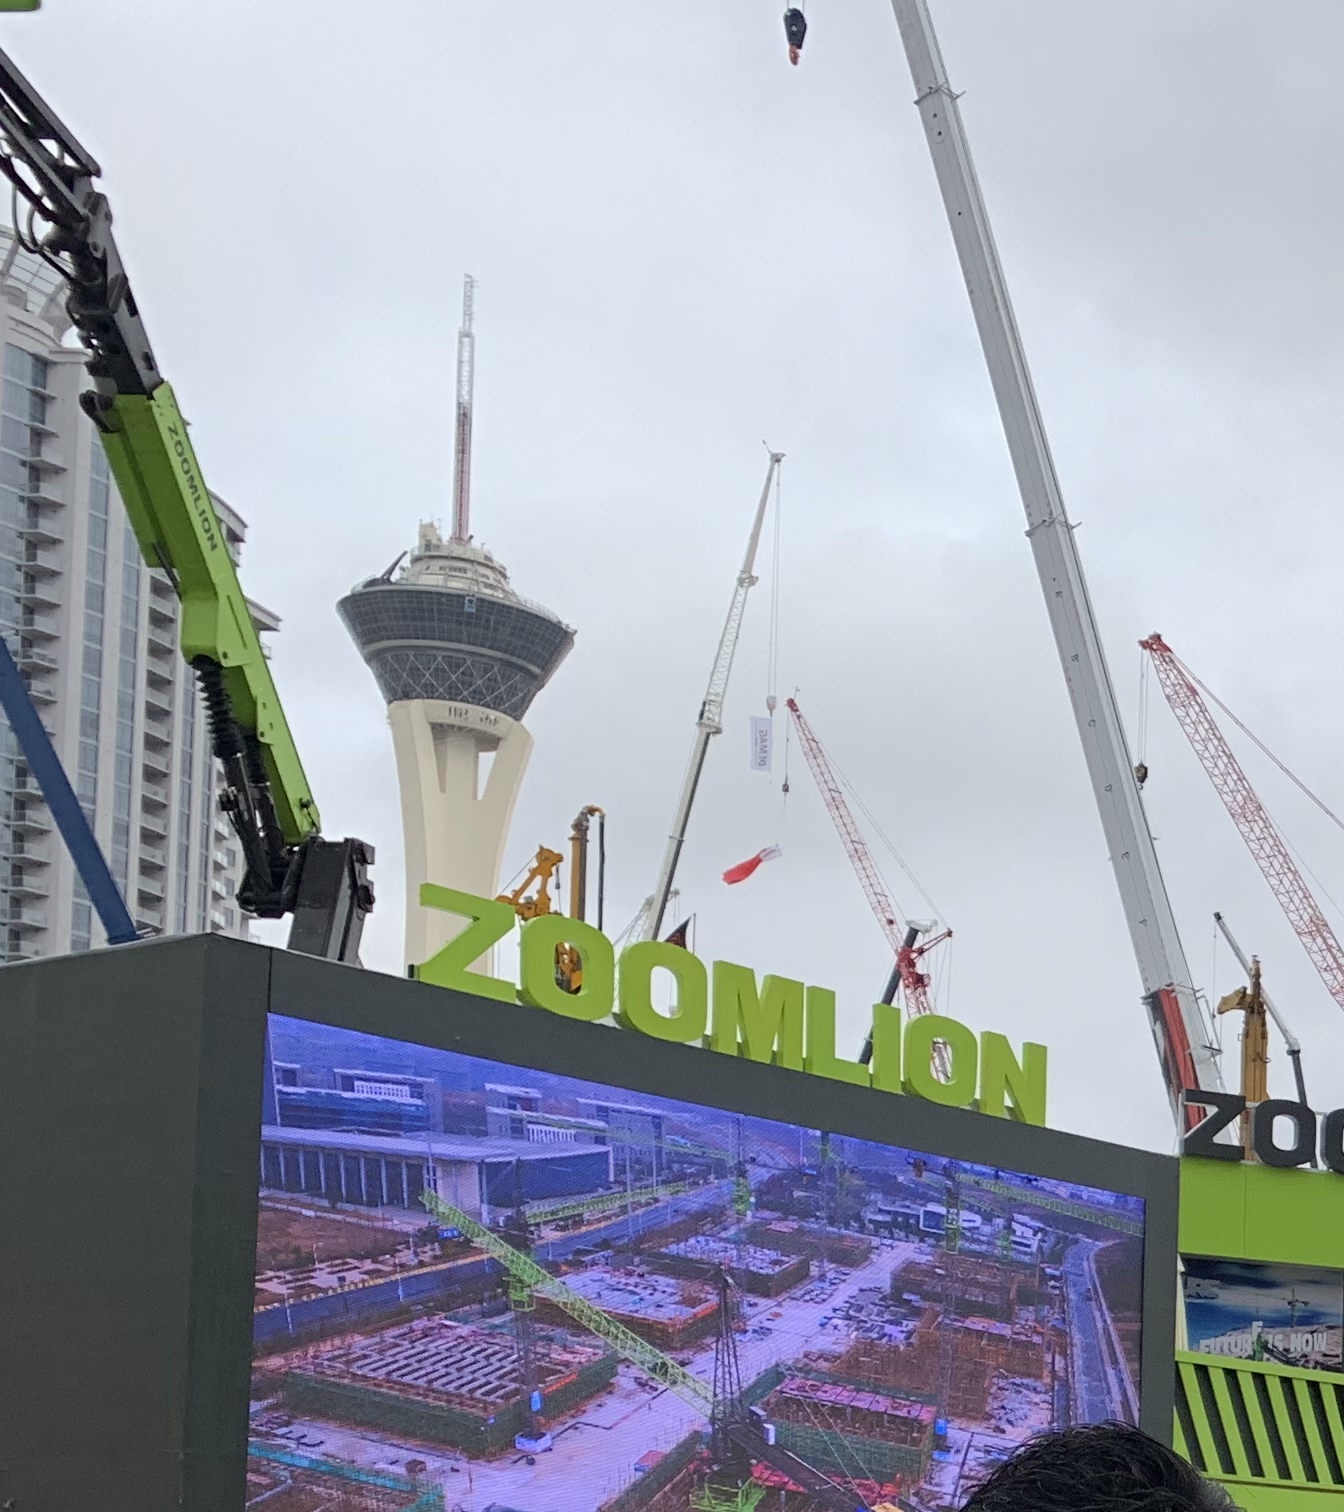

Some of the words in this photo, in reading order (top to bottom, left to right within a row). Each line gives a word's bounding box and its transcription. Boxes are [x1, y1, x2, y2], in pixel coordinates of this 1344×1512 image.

[167, 421, 218, 552] ZOOMLION
[419, 882, 1048, 1128] ZOOMLION
[1290, 1333, 1327, 1351] NOW
